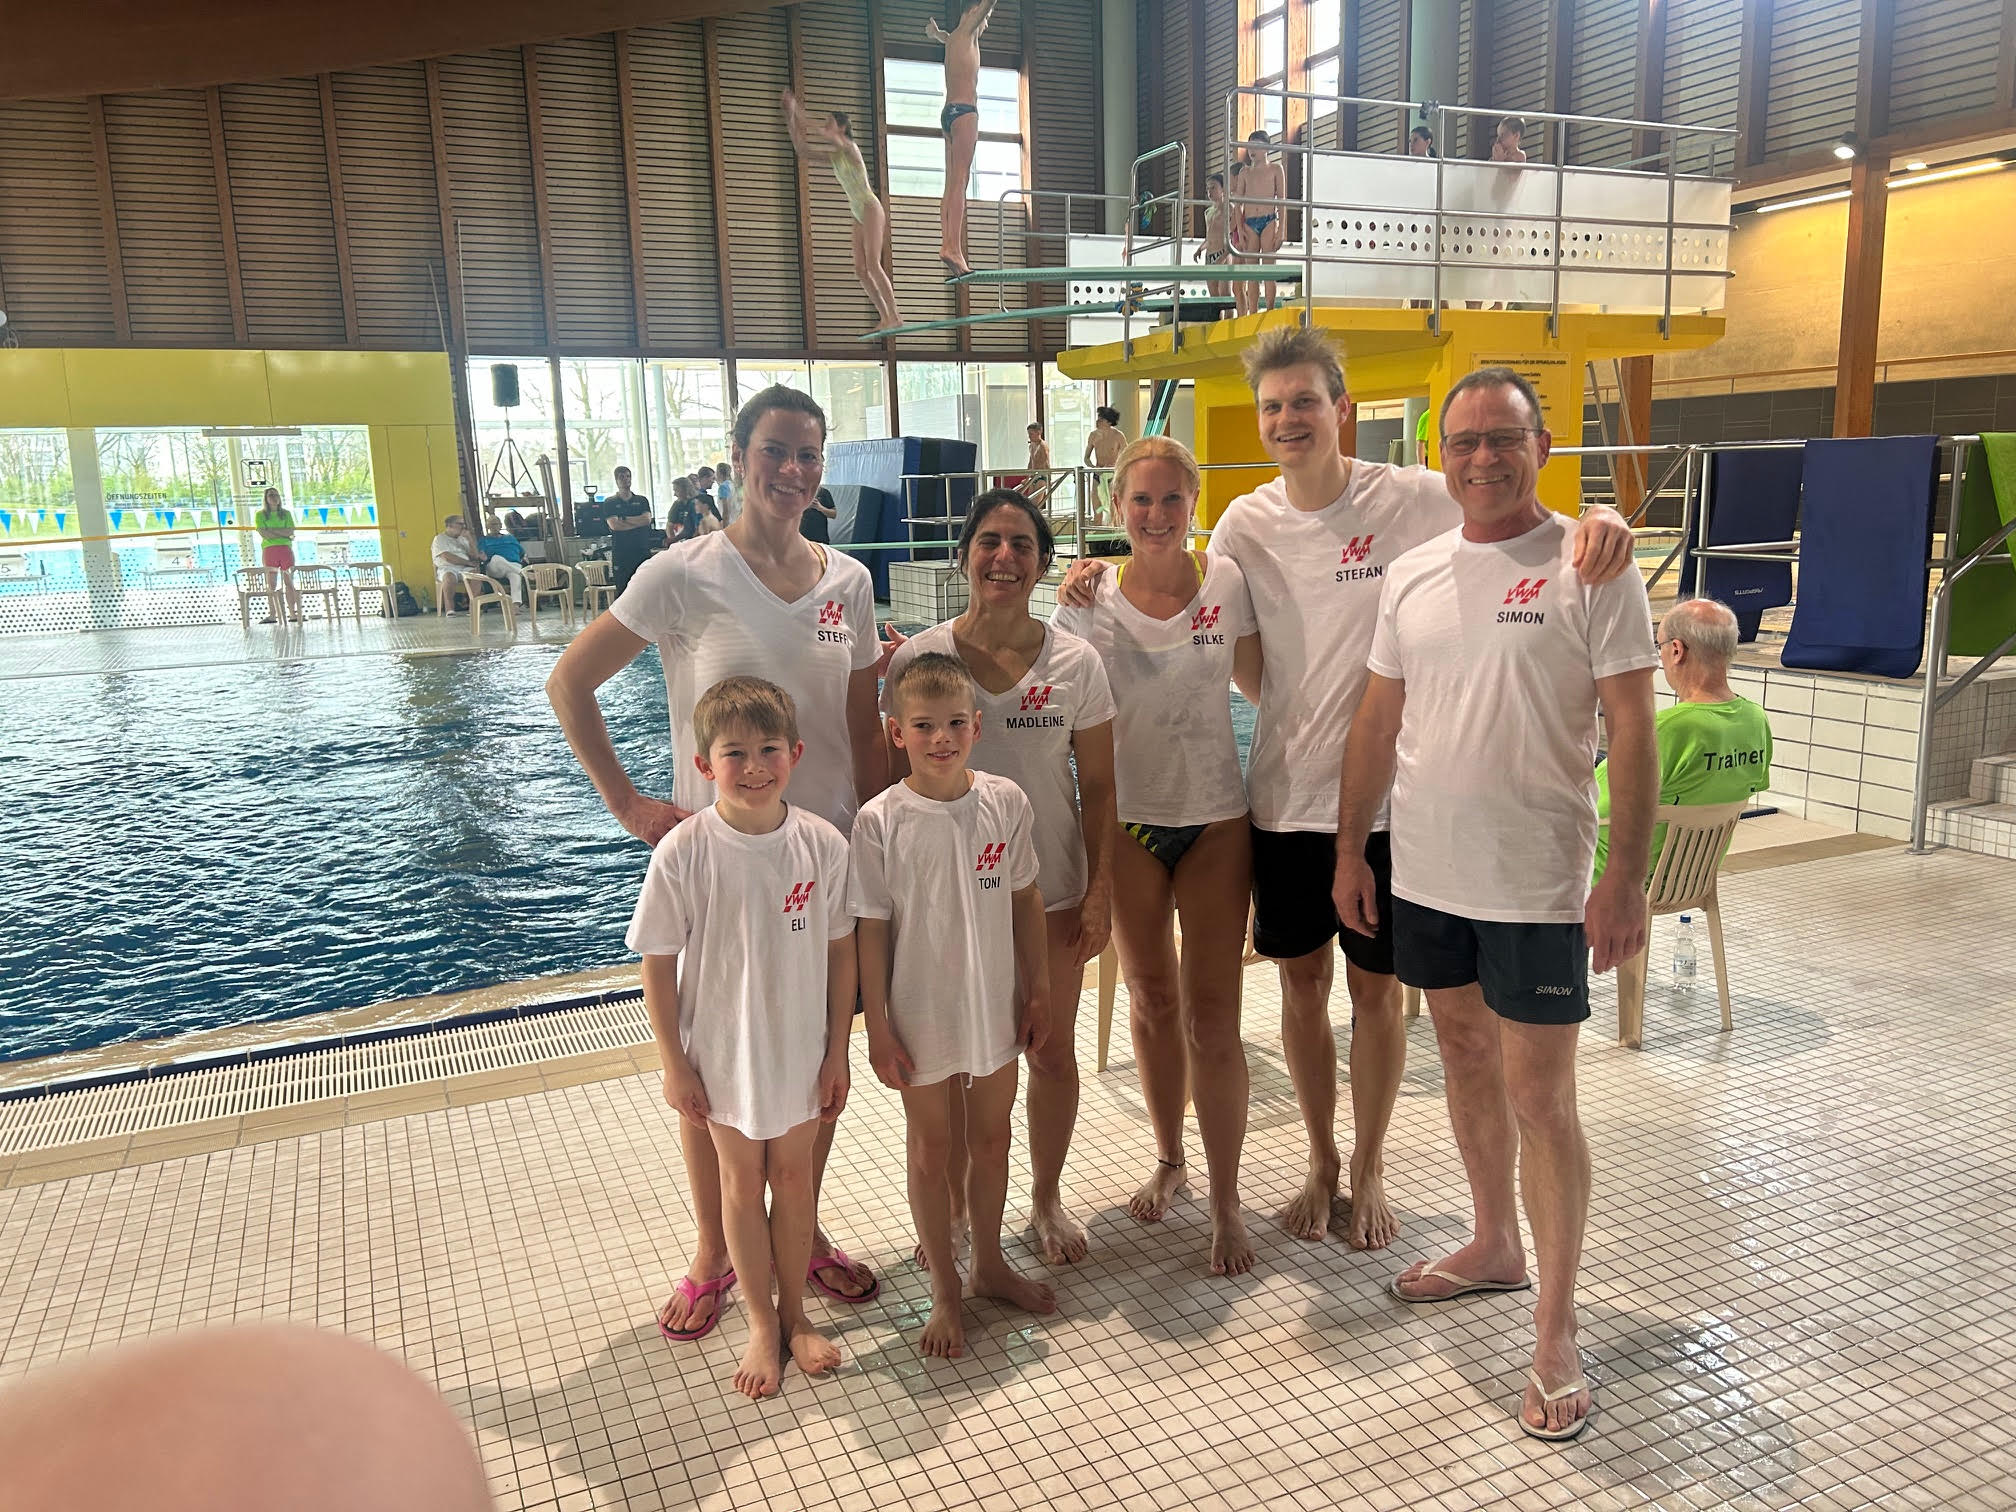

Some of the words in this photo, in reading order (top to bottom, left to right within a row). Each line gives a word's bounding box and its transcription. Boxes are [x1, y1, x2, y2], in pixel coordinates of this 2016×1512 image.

[106, 492, 167, 501] ÖFFNUNGSZEITEN
[171, 556, 181, 566] 4
[0, 563, 11, 574] 5
[1336, 566, 1383, 582] STEFAN
[1497, 611, 1544, 624] SIMON
[1193, 634, 1224, 645] SILKE
[1006, 716, 1064, 728] MADLEINE
[1704, 749, 1764, 770] Trainer
[978, 876, 1000, 890] TONI
[792, 917, 805, 931] ELI
[1535, 985, 1573, 995] SIMON
